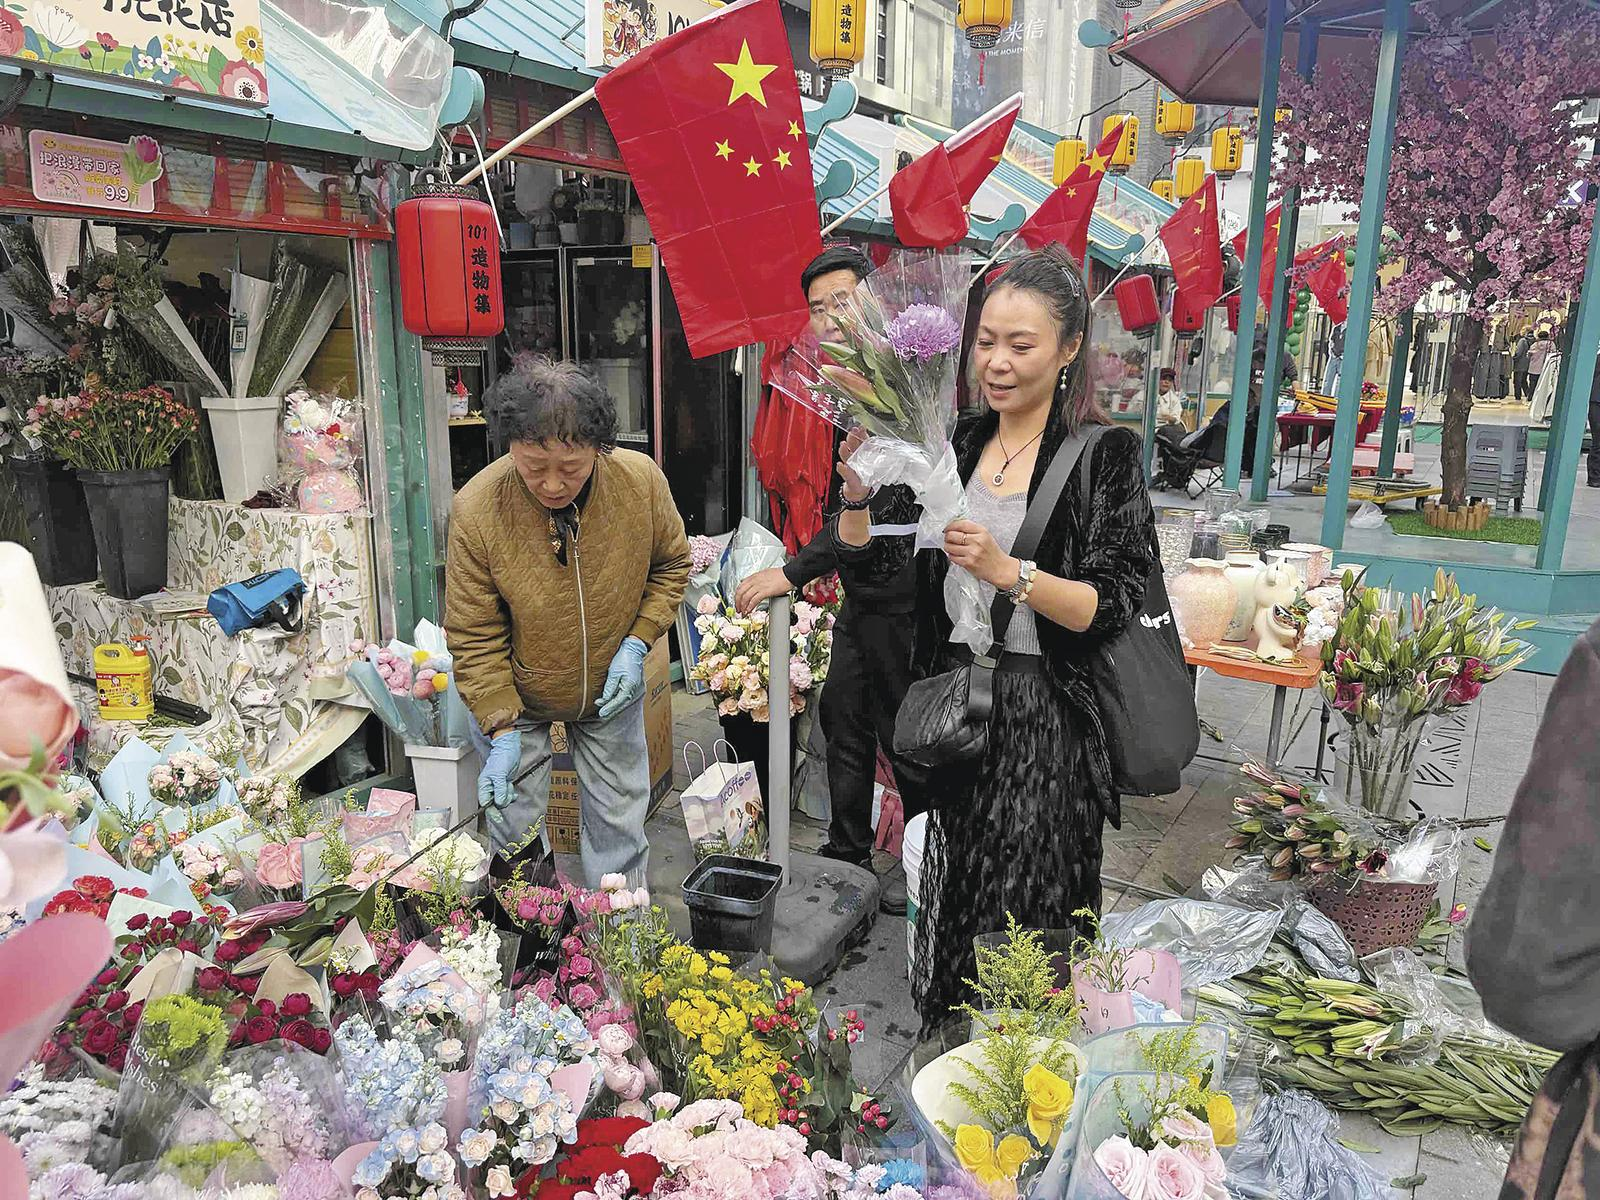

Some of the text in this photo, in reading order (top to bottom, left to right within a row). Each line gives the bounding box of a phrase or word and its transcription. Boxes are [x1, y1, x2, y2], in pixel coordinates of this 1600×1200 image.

[40, 151, 121, 176] 把浪漫带回家
[104, 184, 129, 202] 9.9
[467, 224, 488, 241] 101
[471, 245, 492, 315] 造物集
